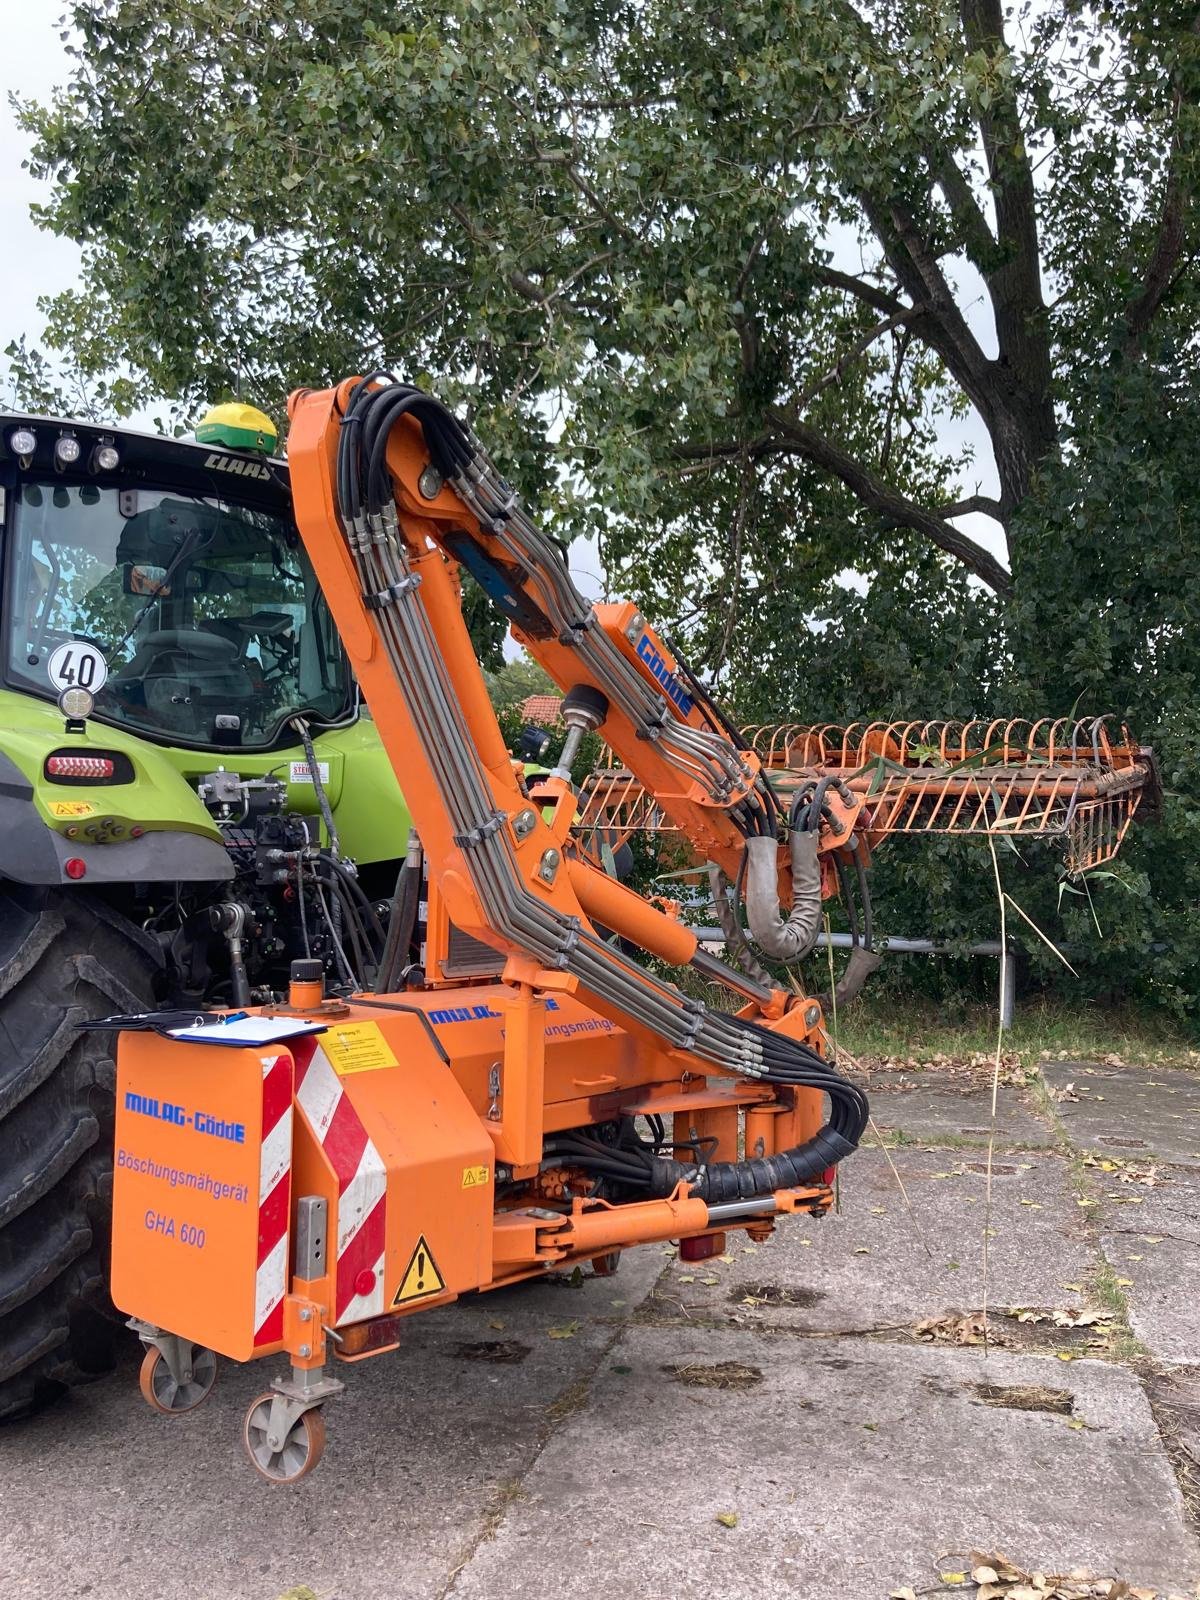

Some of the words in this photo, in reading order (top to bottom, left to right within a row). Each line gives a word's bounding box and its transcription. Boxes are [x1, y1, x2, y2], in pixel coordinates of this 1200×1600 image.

[204, 454, 275, 481] CLAAS
[59, 650, 96, 688] 40
[117, 1150, 249, 1203] Böschungsmähgerät
[145, 1210, 176, 1239] GHA
[180, 1223, 206, 1249] 600
